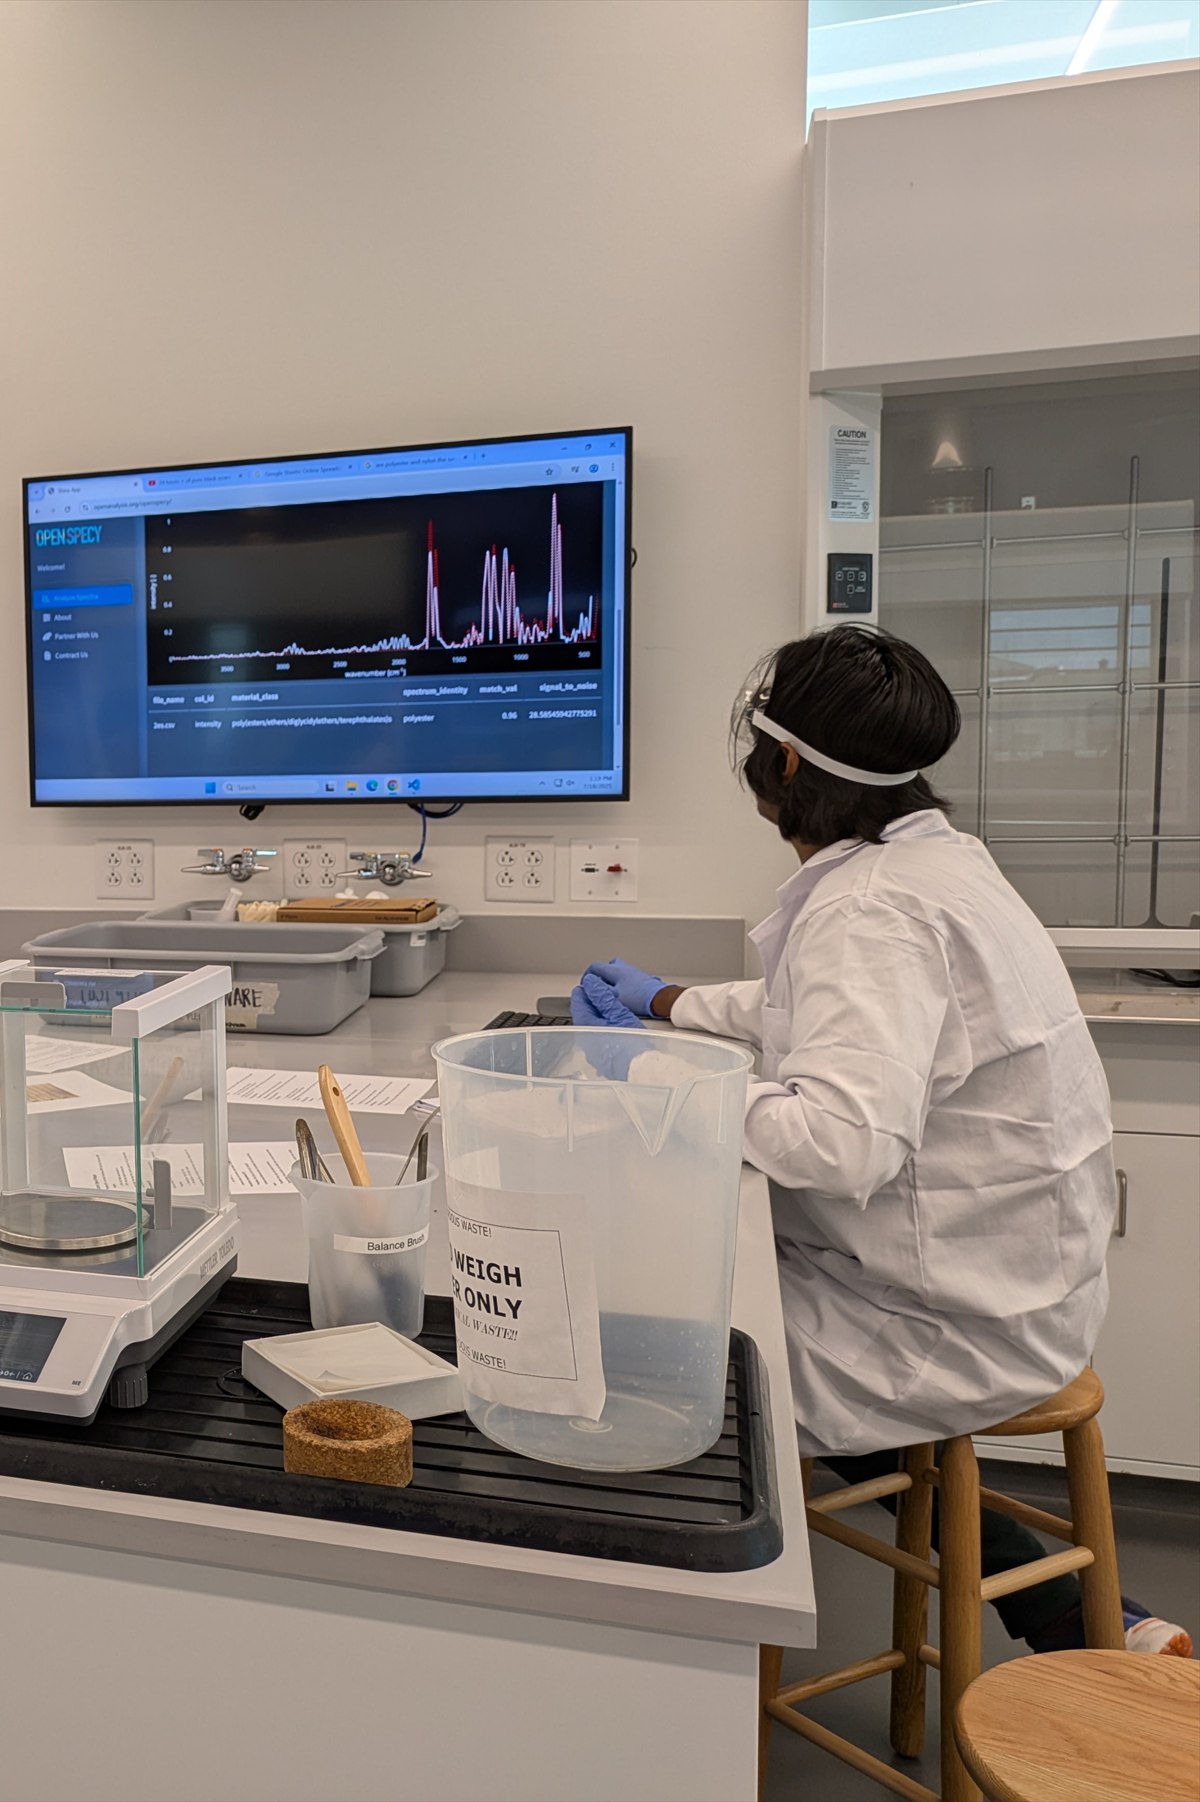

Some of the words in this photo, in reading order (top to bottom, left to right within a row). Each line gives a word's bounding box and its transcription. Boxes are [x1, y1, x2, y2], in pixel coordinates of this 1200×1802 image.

[837, 430, 867, 439] CAUTION
[36, 529, 66, 546] OPEN
[67, 525, 102, 544] SPECY
[37, 563, 65, 572] Welcome!
[54, 614, 72, 622] About
[77, 632, 90, 640] With
[90, 631, 99, 639] Us
[80, 651, 88, 659] Us
[514, 653, 529, 661] 1000
[578, 650, 590, 658] 500
[344, 669, 387, 678] wavenumber
[231, 692, 279, 702] material_class
[403, 685, 469, 697] spectrum_identity
[479, 684, 518, 694] match_val
[539, 681, 598, 693] signal_to_noise
[195, 720, 222, 729] intensity
[403, 713, 435, 723] polyester
[461, 1219, 492, 1238] WASTE!
[367, 1241, 405, 1251] Balance
[454, 1247, 522, 1288] WEIGH
[465, 1286, 522, 1319] ONLY
[473, 1319, 518, 1341] WASTE!!
[471, 1349, 507, 1369] WASTE!
